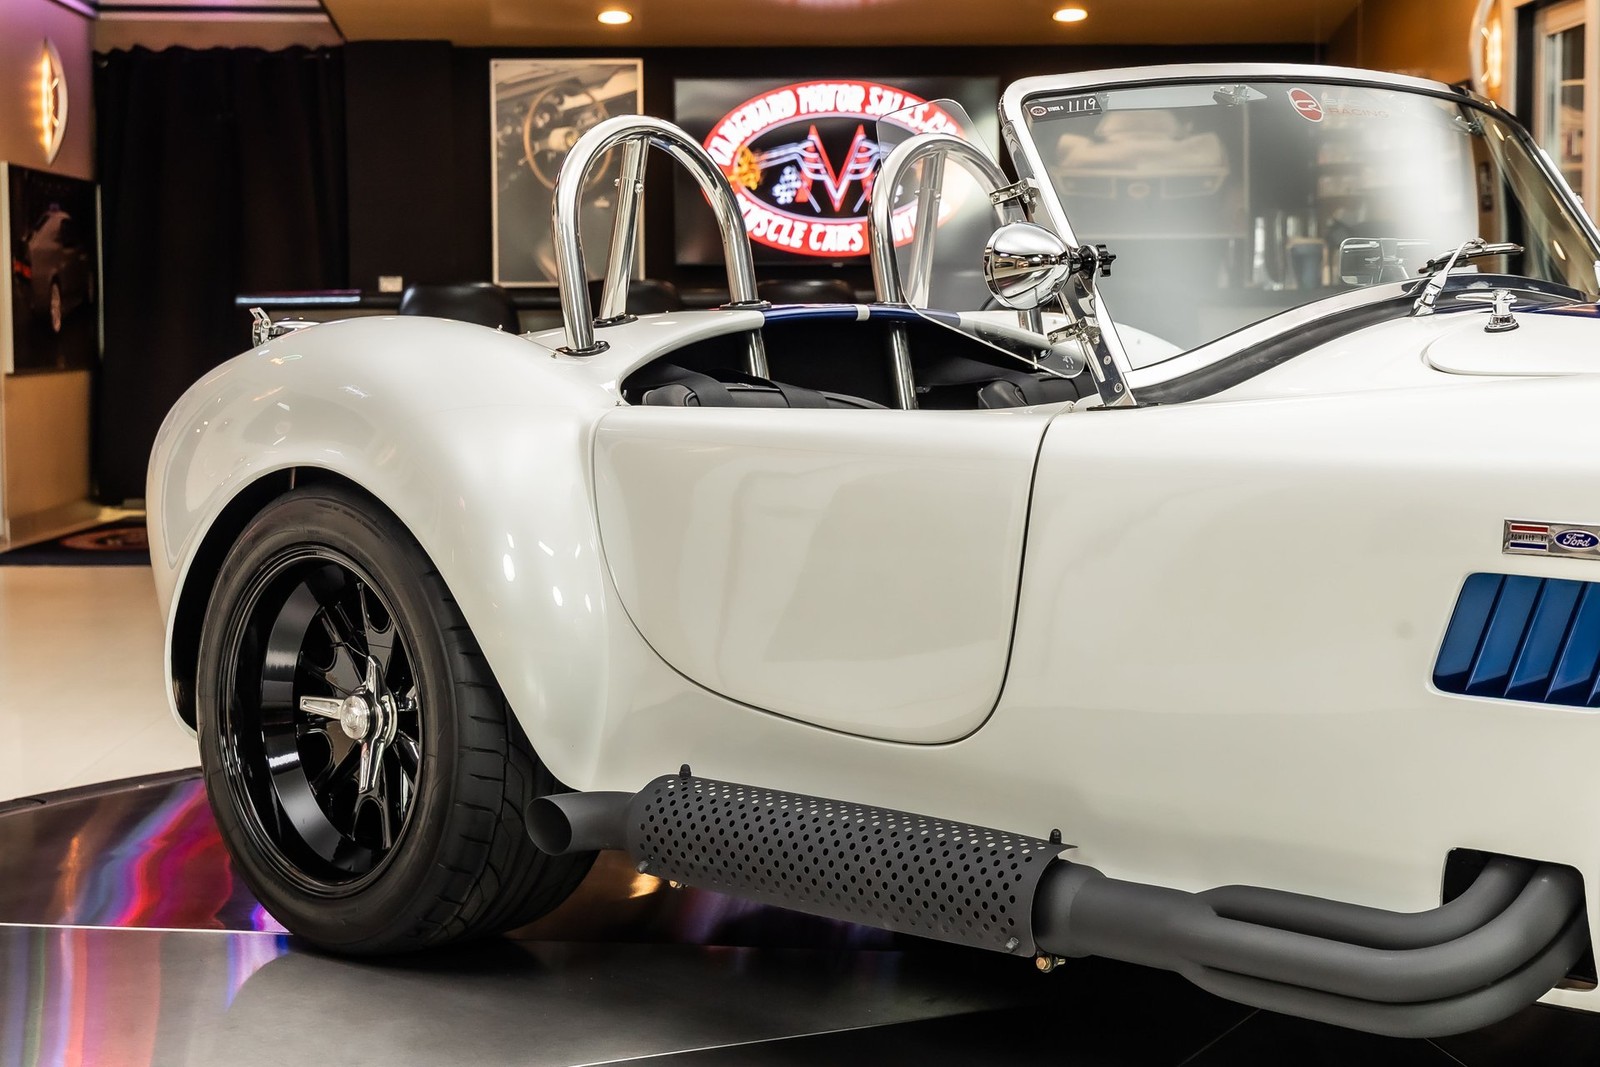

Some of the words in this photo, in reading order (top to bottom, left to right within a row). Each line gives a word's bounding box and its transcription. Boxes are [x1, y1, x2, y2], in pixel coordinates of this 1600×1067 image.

[1068, 98, 1096, 112] 1119
[1327, 107, 1389, 118] RACING
[809, 223, 863, 252] CARS
[1562, 533, 1592, 547] Ford
